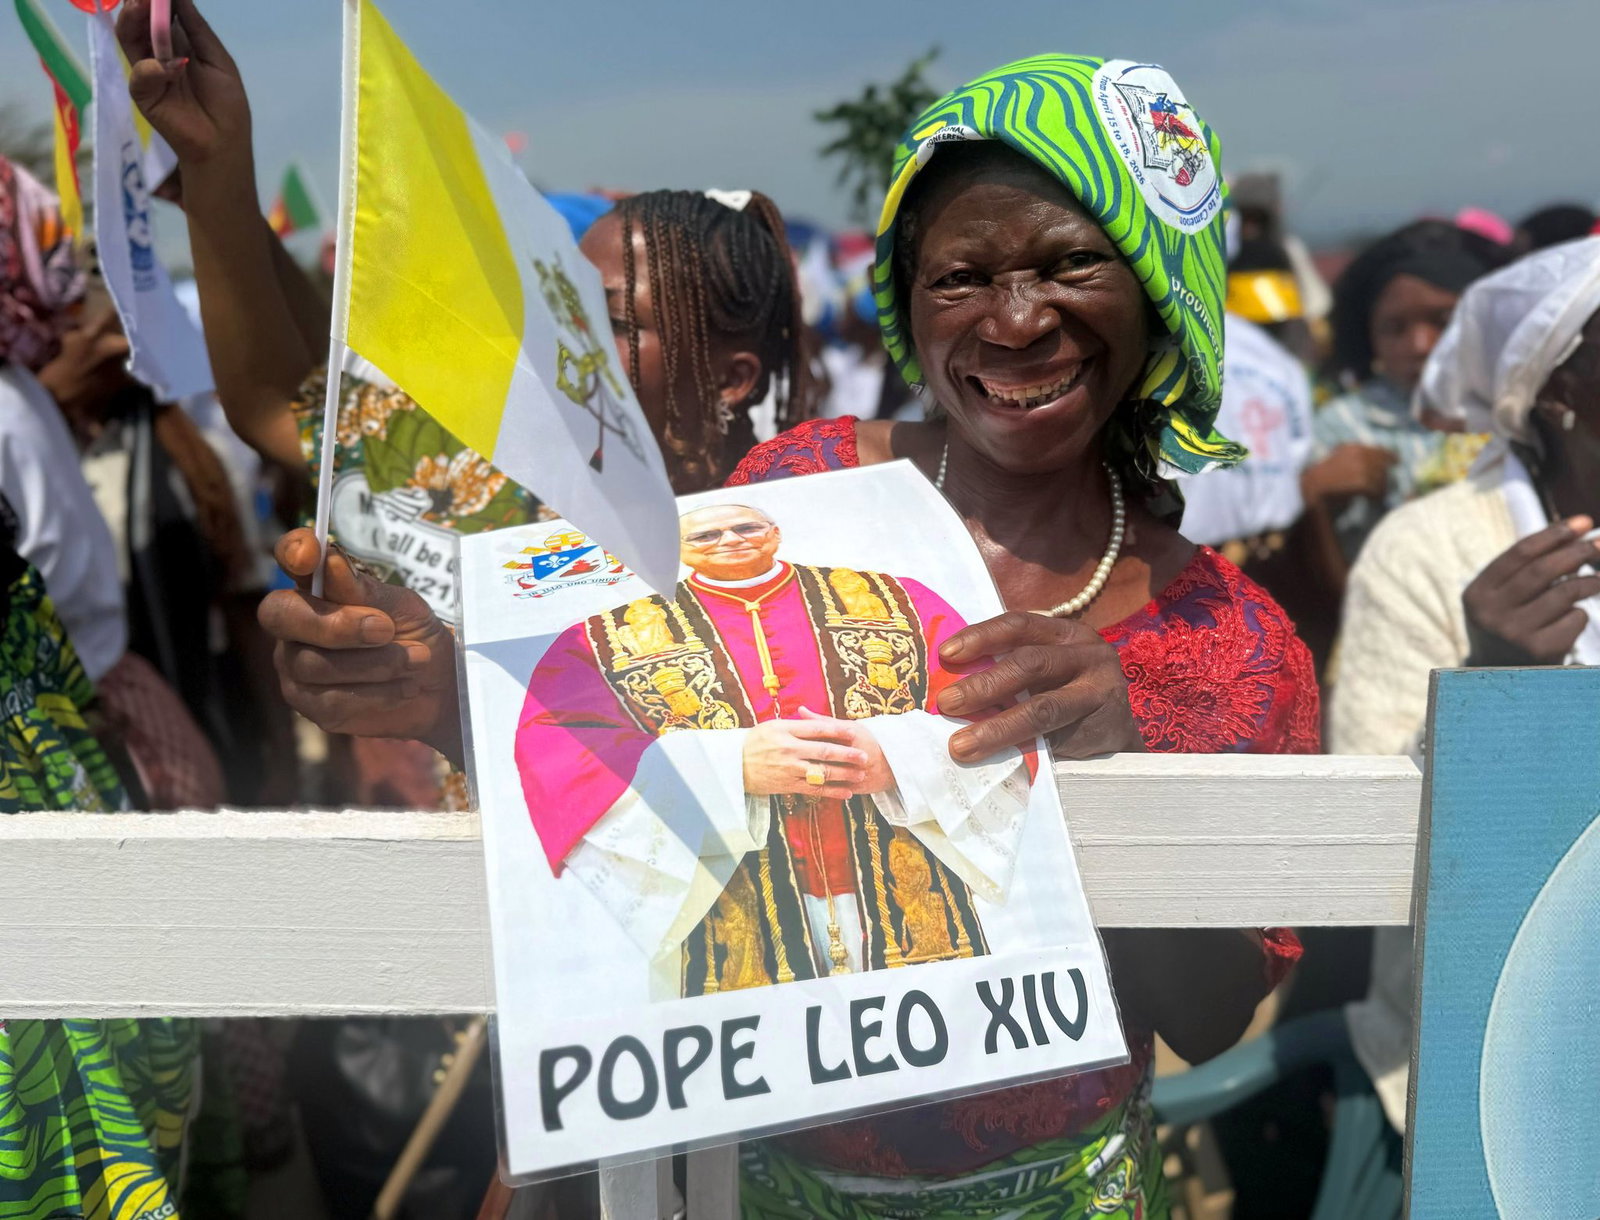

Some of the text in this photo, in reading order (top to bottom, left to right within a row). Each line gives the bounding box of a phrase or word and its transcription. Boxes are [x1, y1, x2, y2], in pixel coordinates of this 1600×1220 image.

[1100, 75, 1111, 92] From
[1098, 92, 1113, 114] April
[1106, 114, 1117, 128] 15
[1113, 128, 1121, 141] to
[1129, 159, 1145, 185] 2026
[1208, 201, 1217, 211] to
[415, 541, 441, 568] be
[538, 968, 1089, 1132] POPE LEO XIV
